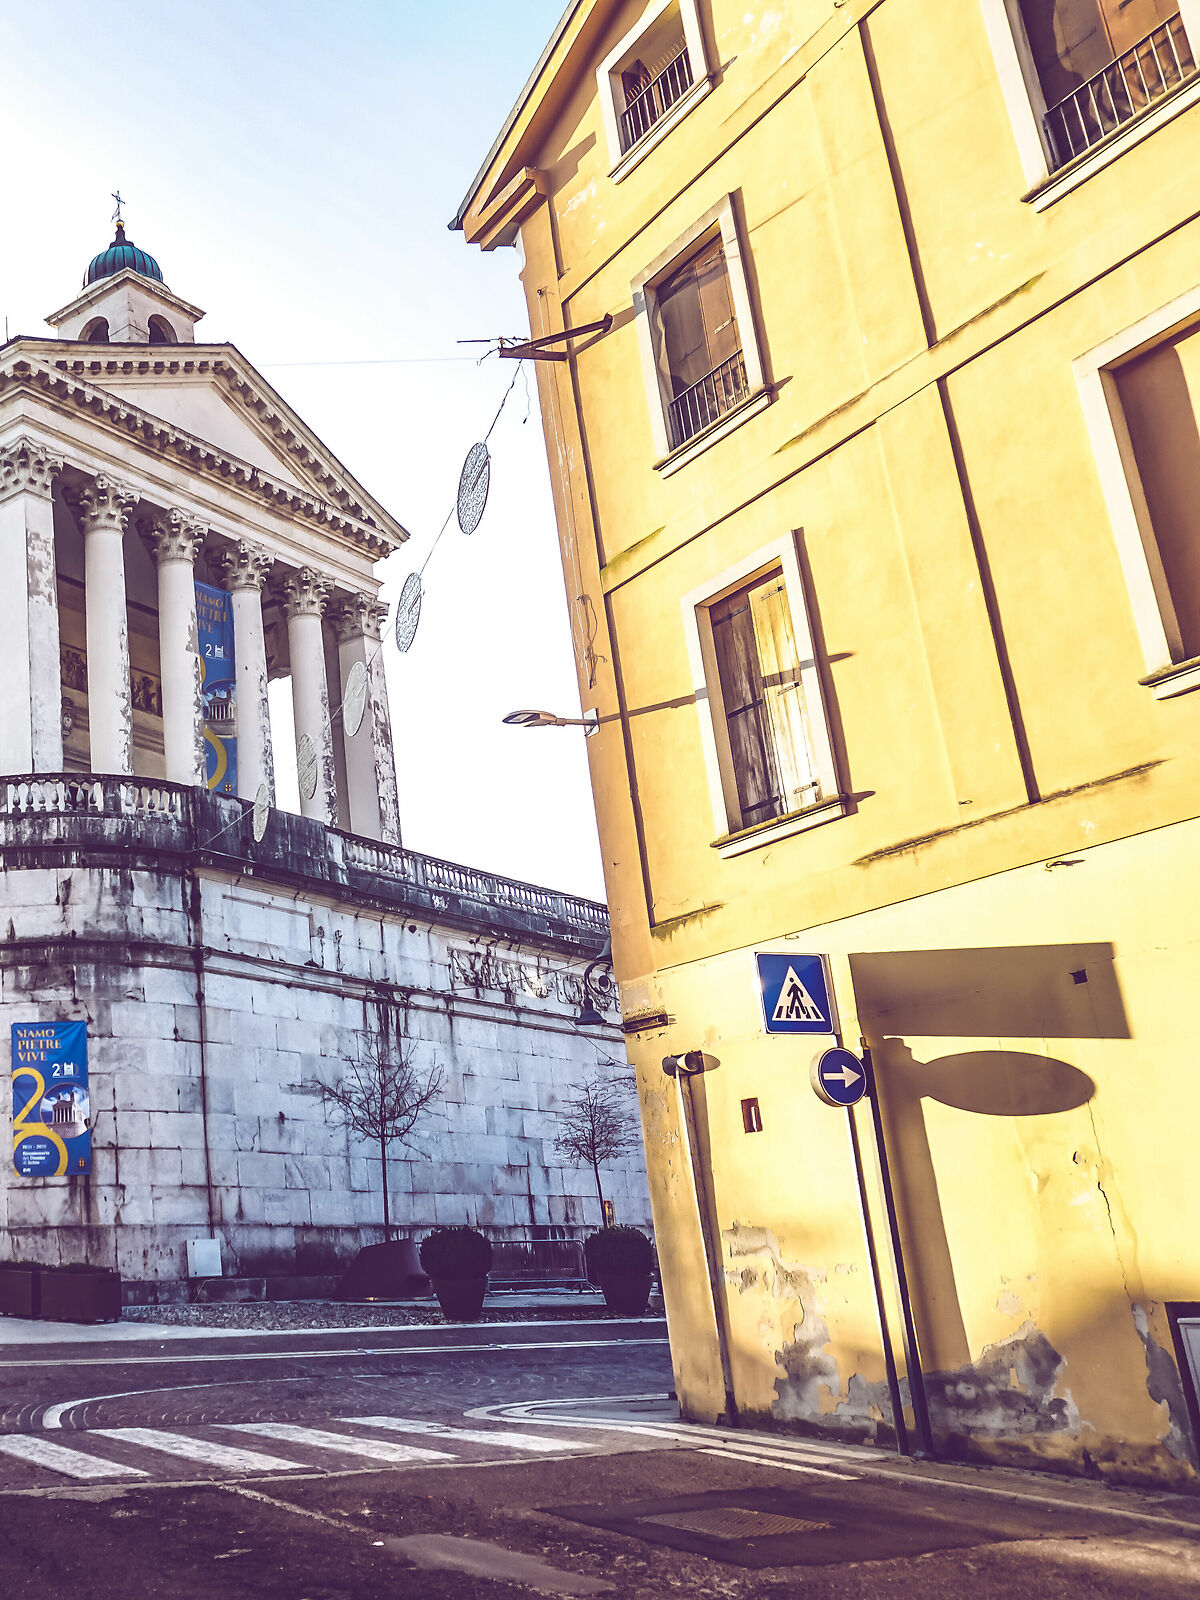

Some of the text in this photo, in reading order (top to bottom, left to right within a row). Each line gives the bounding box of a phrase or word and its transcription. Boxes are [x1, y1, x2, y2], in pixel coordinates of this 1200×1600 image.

[17, 1029, 55, 1038] SIAMO
[18, 1039, 62, 1050] PIETRE
[18, 1051, 48, 1062] VIVE
